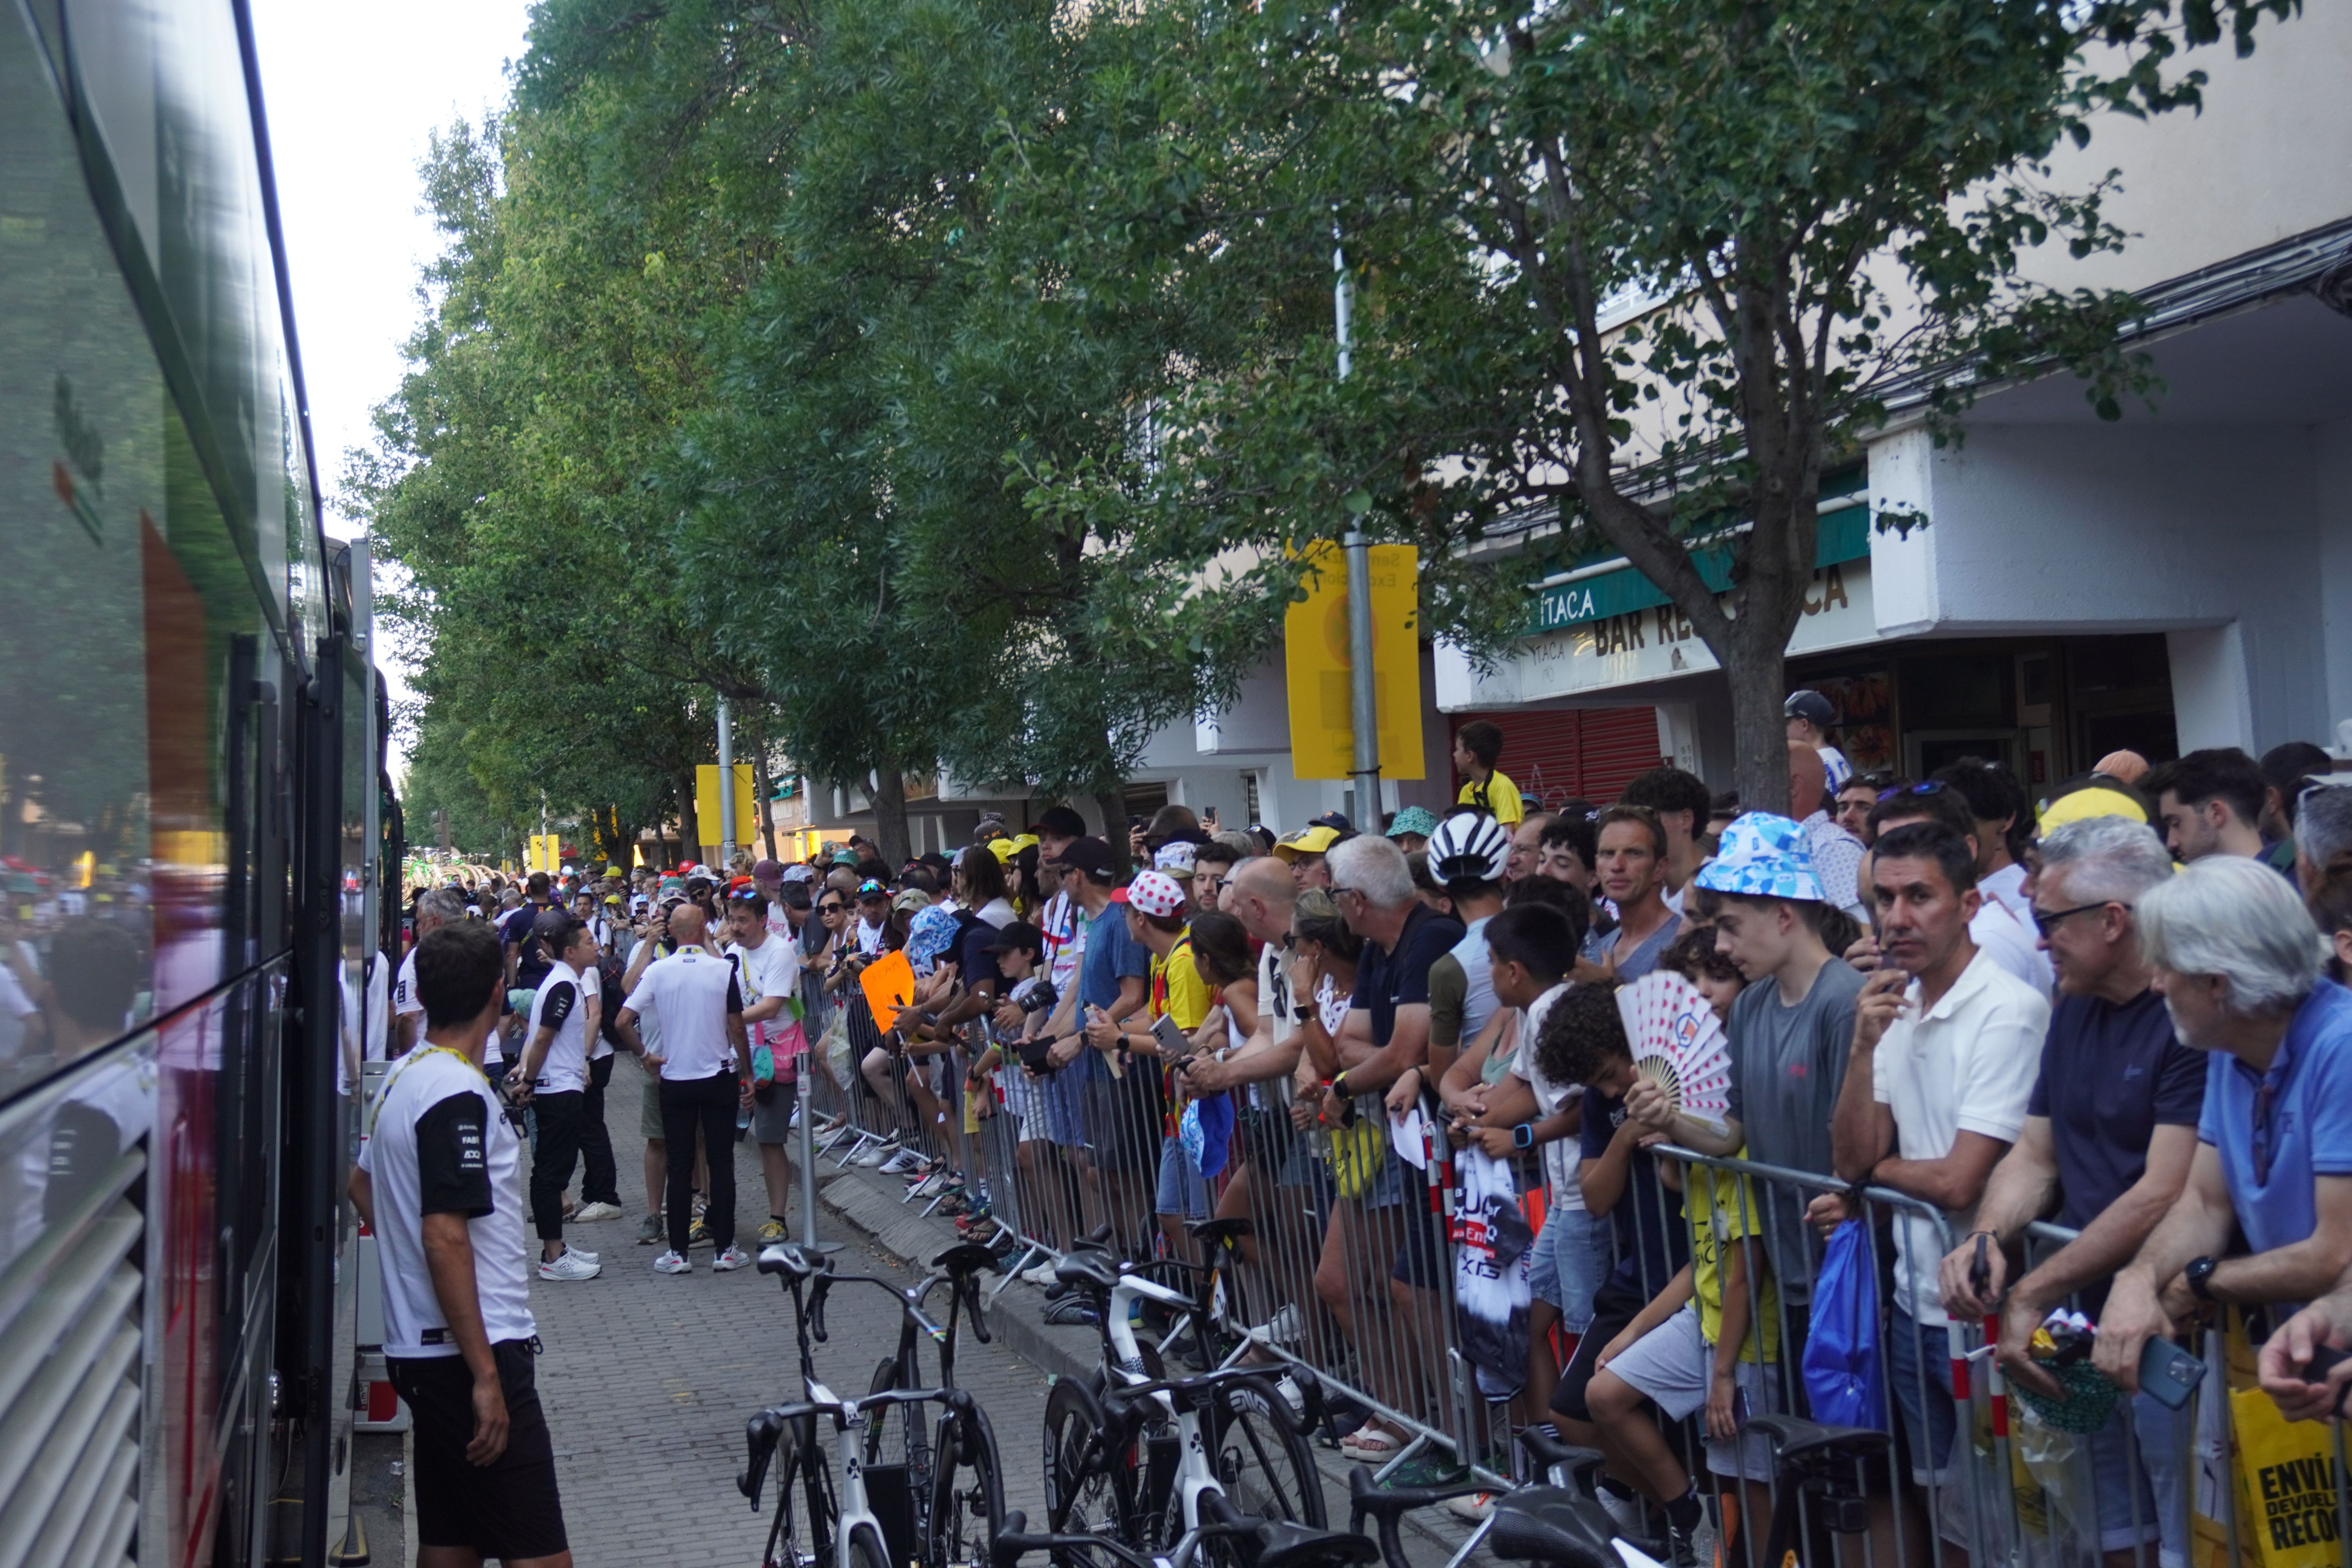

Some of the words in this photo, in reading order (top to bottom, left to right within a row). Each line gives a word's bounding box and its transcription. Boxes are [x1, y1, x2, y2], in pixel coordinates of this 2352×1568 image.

[1592, 610, 1645, 657] BAR
[2265, 1490, 2337, 1517] DEVUEL
[2269, 1509, 2339, 1551] RECO
